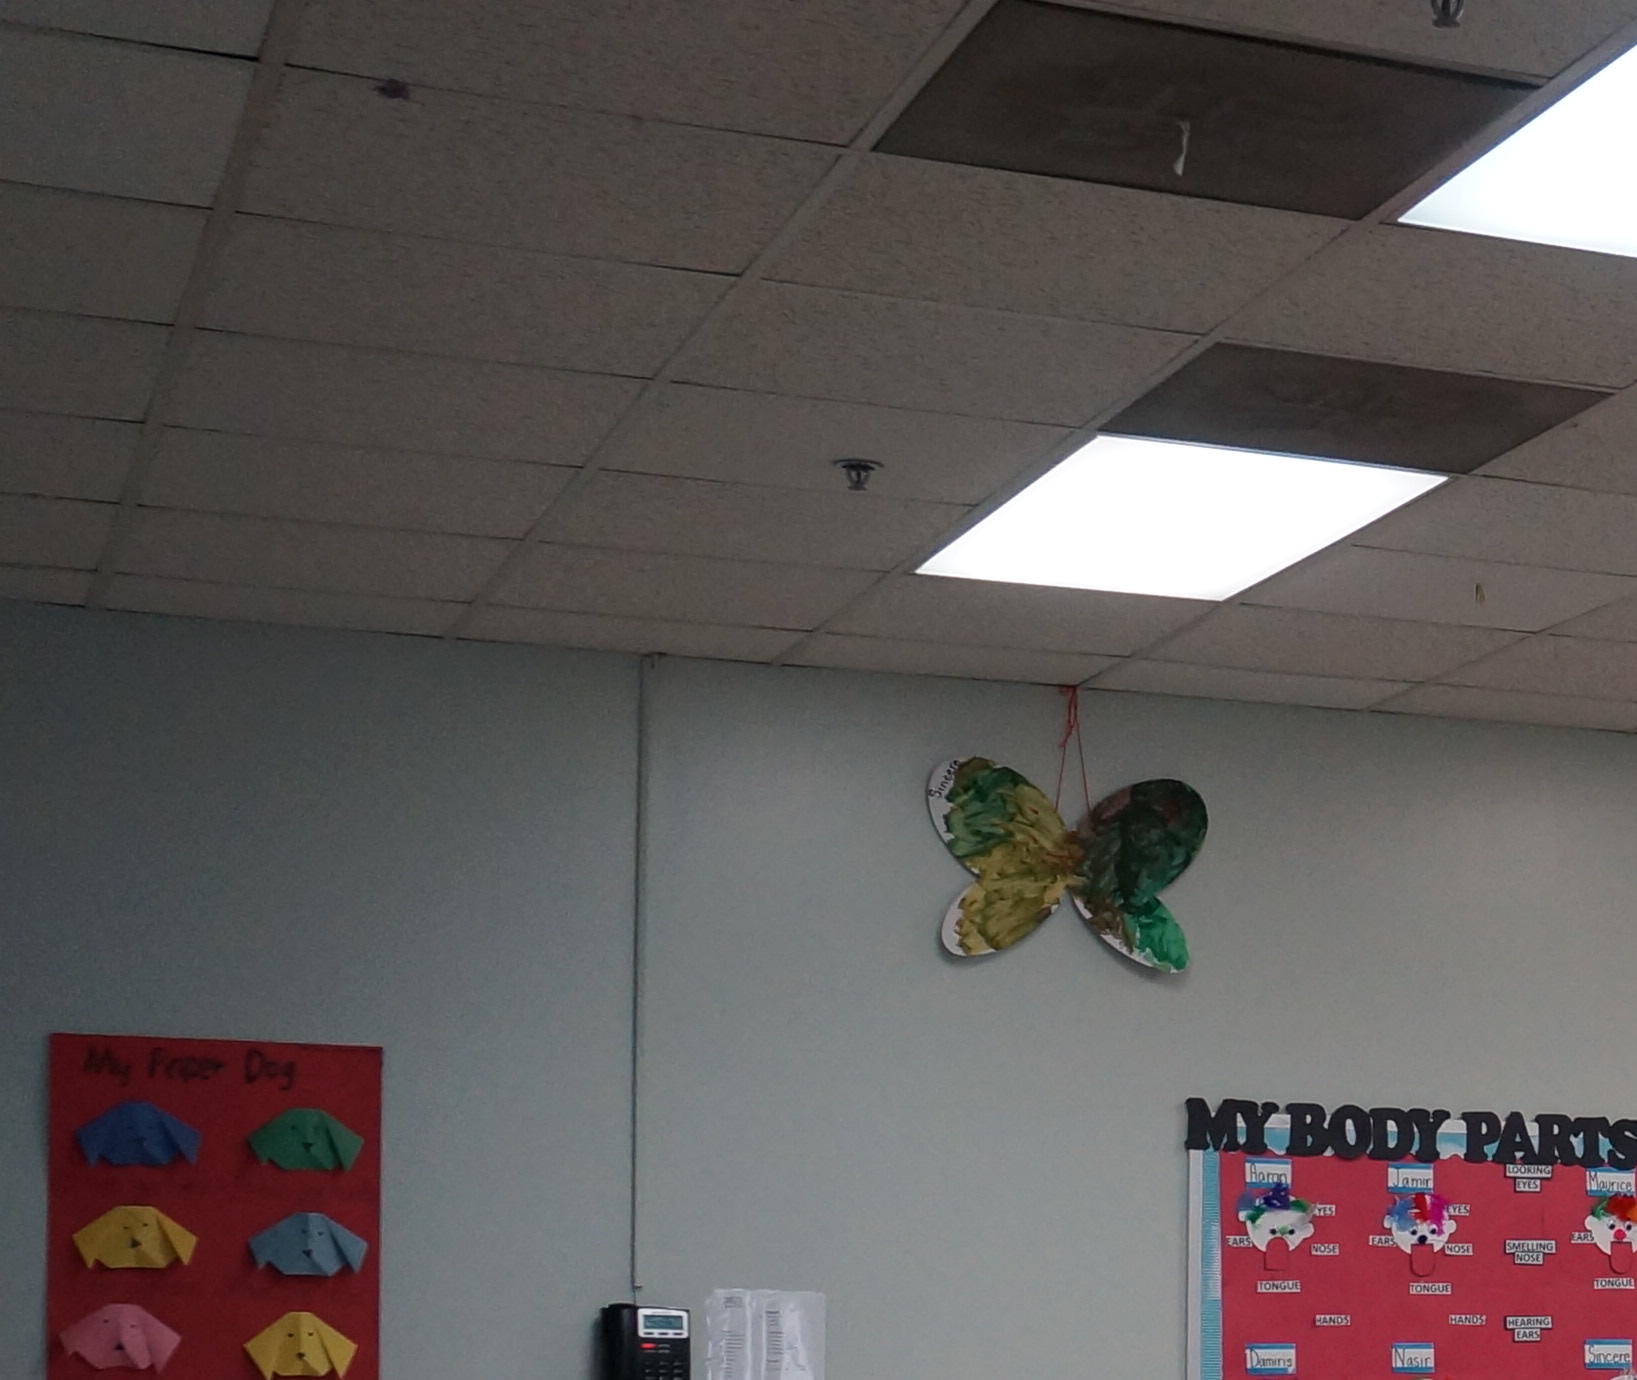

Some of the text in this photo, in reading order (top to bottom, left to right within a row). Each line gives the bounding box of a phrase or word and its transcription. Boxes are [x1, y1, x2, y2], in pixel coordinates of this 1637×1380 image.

[244, 1049, 296, 1092] Dog
[1185, 1097, 1279, 1153] MY
[1286, 1102, 1450, 1161] BODY
[1507, 1165, 1551, 1176] LOOKING
[1516, 1180, 1539, 1190] EYES
[1313, 1244, 1338, 1253] NOSE
[1446, 1245, 1470, 1254] NOSE
[1507, 1241, 1554, 1252] SMELLING
[1516, 1253, 1542, 1263] NOSE
[1258, 1281, 1300, 1292] TONGUE
[1410, 1283, 1450, 1293] TONGUE
[1595, 1278, 1635, 1288] TONGUE
[1316, 1315, 1350, 1325] HANDS
[1450, 1315, 1484, 1325] HANDS
[1508, 1317, 1550, 1328] HEARING
[1516, 1330, 1540, 1339] EARS
